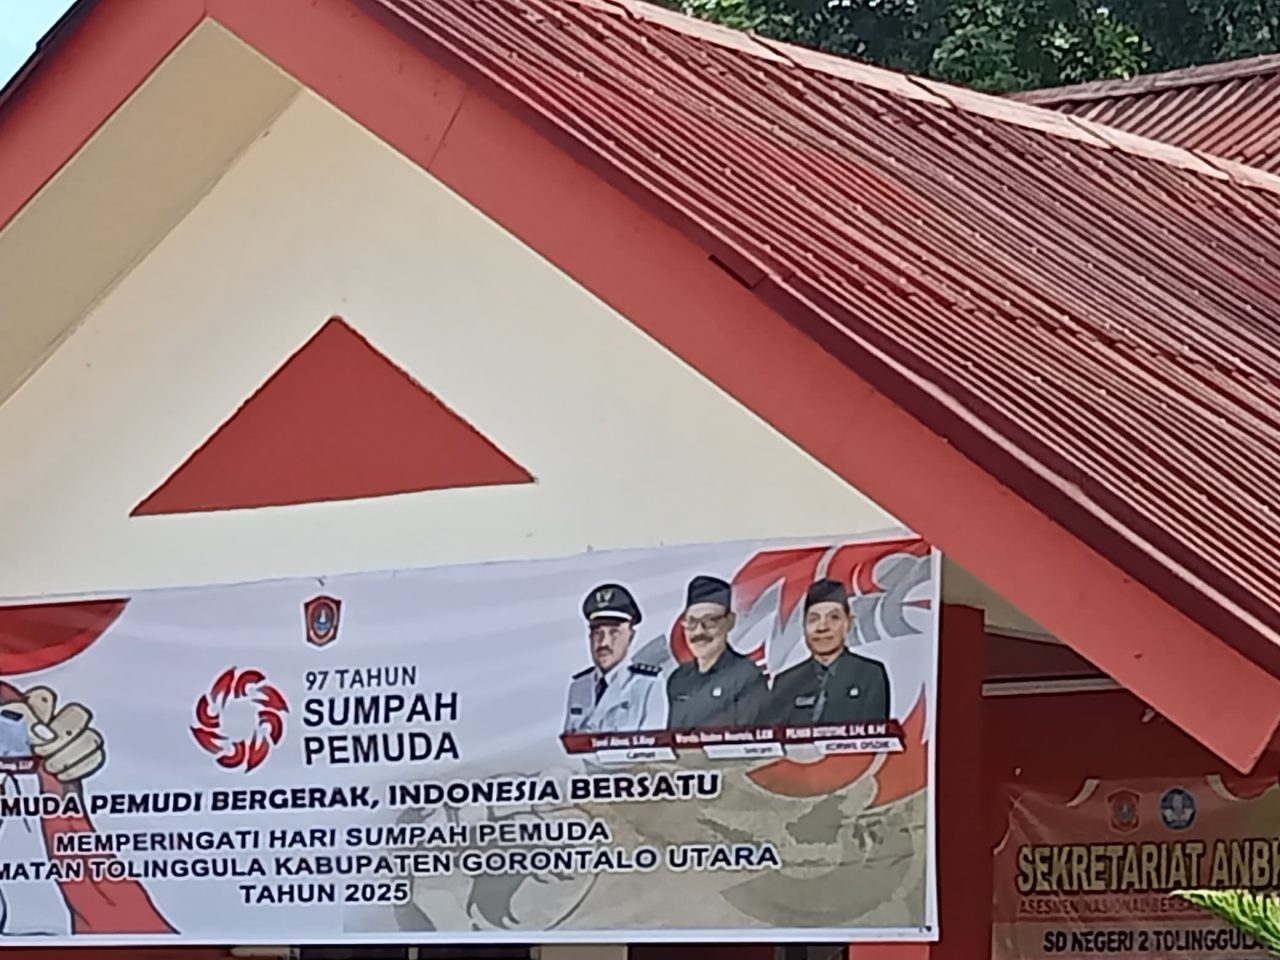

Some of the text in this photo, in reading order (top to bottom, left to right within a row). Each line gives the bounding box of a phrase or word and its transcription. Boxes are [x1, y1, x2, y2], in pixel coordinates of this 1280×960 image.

[305, 665, 417, 691] 97 TAHUN
[303, 692, 458, 727] SUMPAH
[304, 731, 460, 766] PEMUDA
[90, 792, 203, 815] PEMUDI
[211, 785, 380, 811] BERGERAK,
[389, 779, 560, 806] INDONESIA
[570, 773, 720, 800] BERSATU
[56, 821, 610, 854] MEMPERINGATI HARI SUMPAH PEMUDA
[90, 858, 266, 880] TOLINGGULA
[275, 853, 451, 876] KABUPATEN
[463, 849, 657, 873] GORONTALO
[669, 847, 779, 869] UTARA
[1016, 841, 1204, 893] SEKRETARIAT
[240, 883, 409, 904] TAHUN 2025
[1043, 931, 1068, 952] SD
[1071, 930, 1133, 952] NEGERI
[1137, 930, 1150, 951] 2
